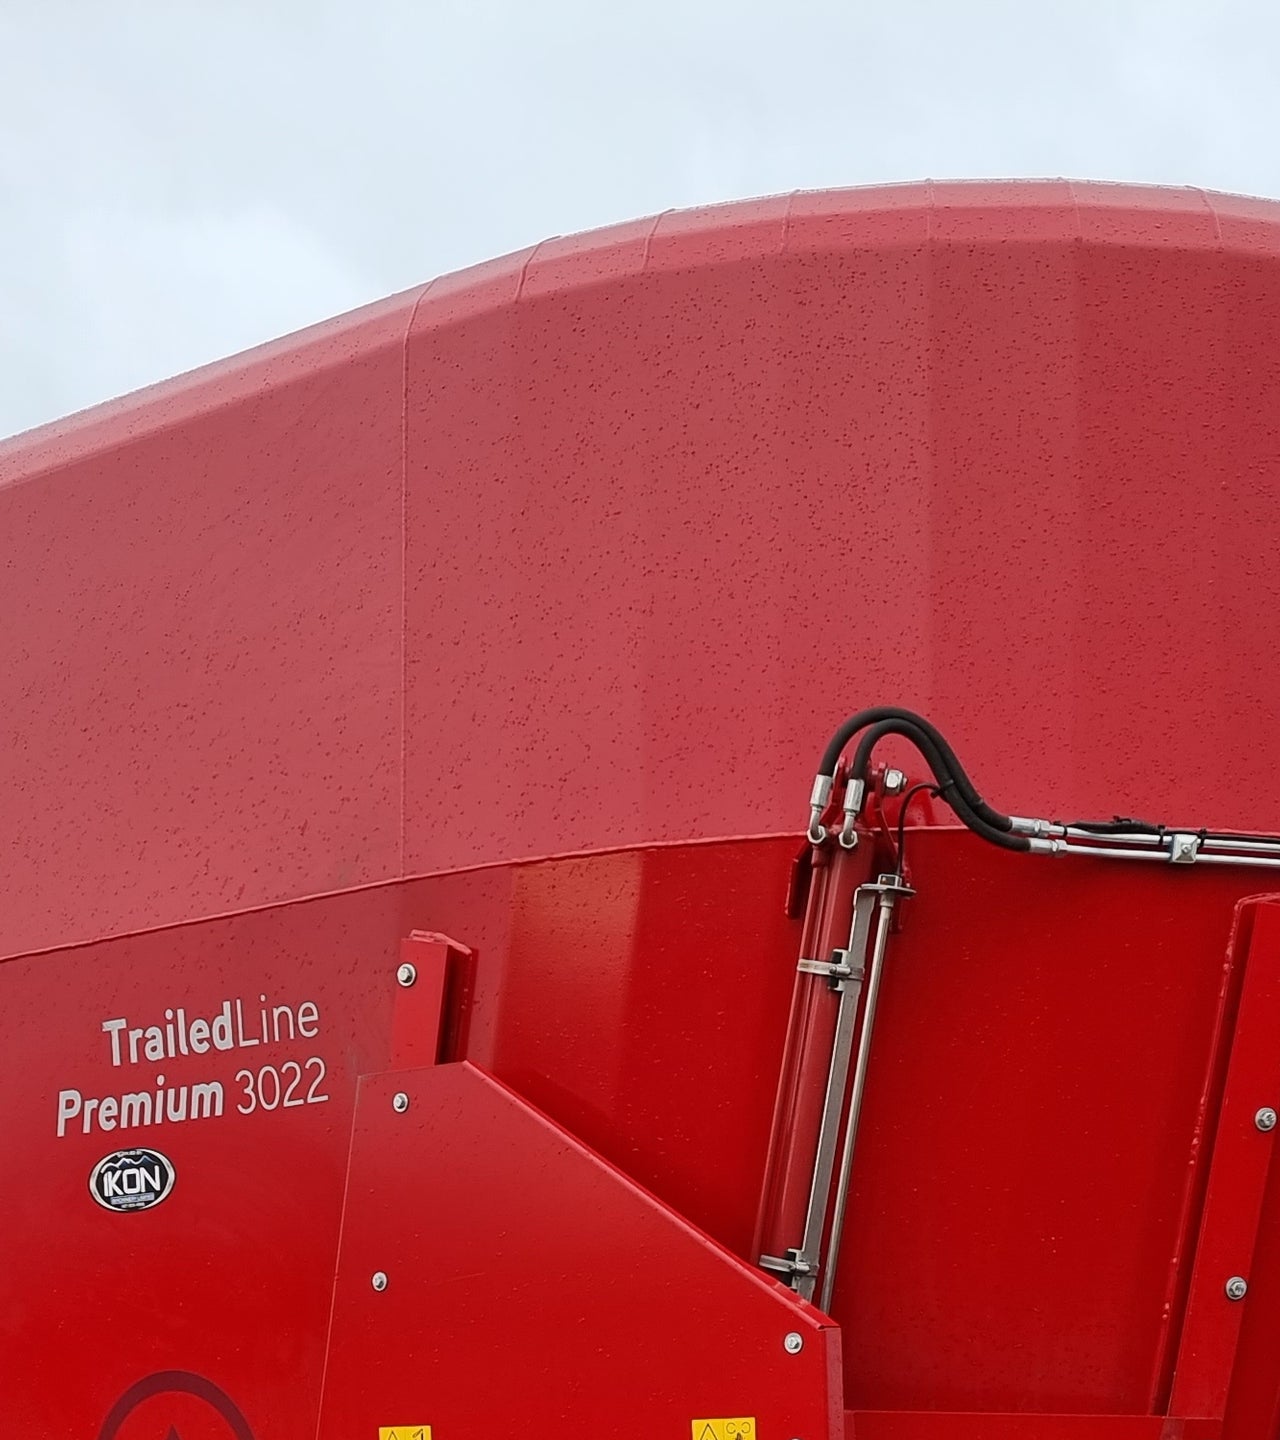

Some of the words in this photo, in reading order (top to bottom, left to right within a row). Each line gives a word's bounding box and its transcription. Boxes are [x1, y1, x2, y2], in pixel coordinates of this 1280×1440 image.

[101, 994, 320, 1067] TrailedLine
[56, 1074, 225, 1138] Premium
[234, 1056, 330, 1115] 3022
[103, 1165, 161, 1197] IKON
